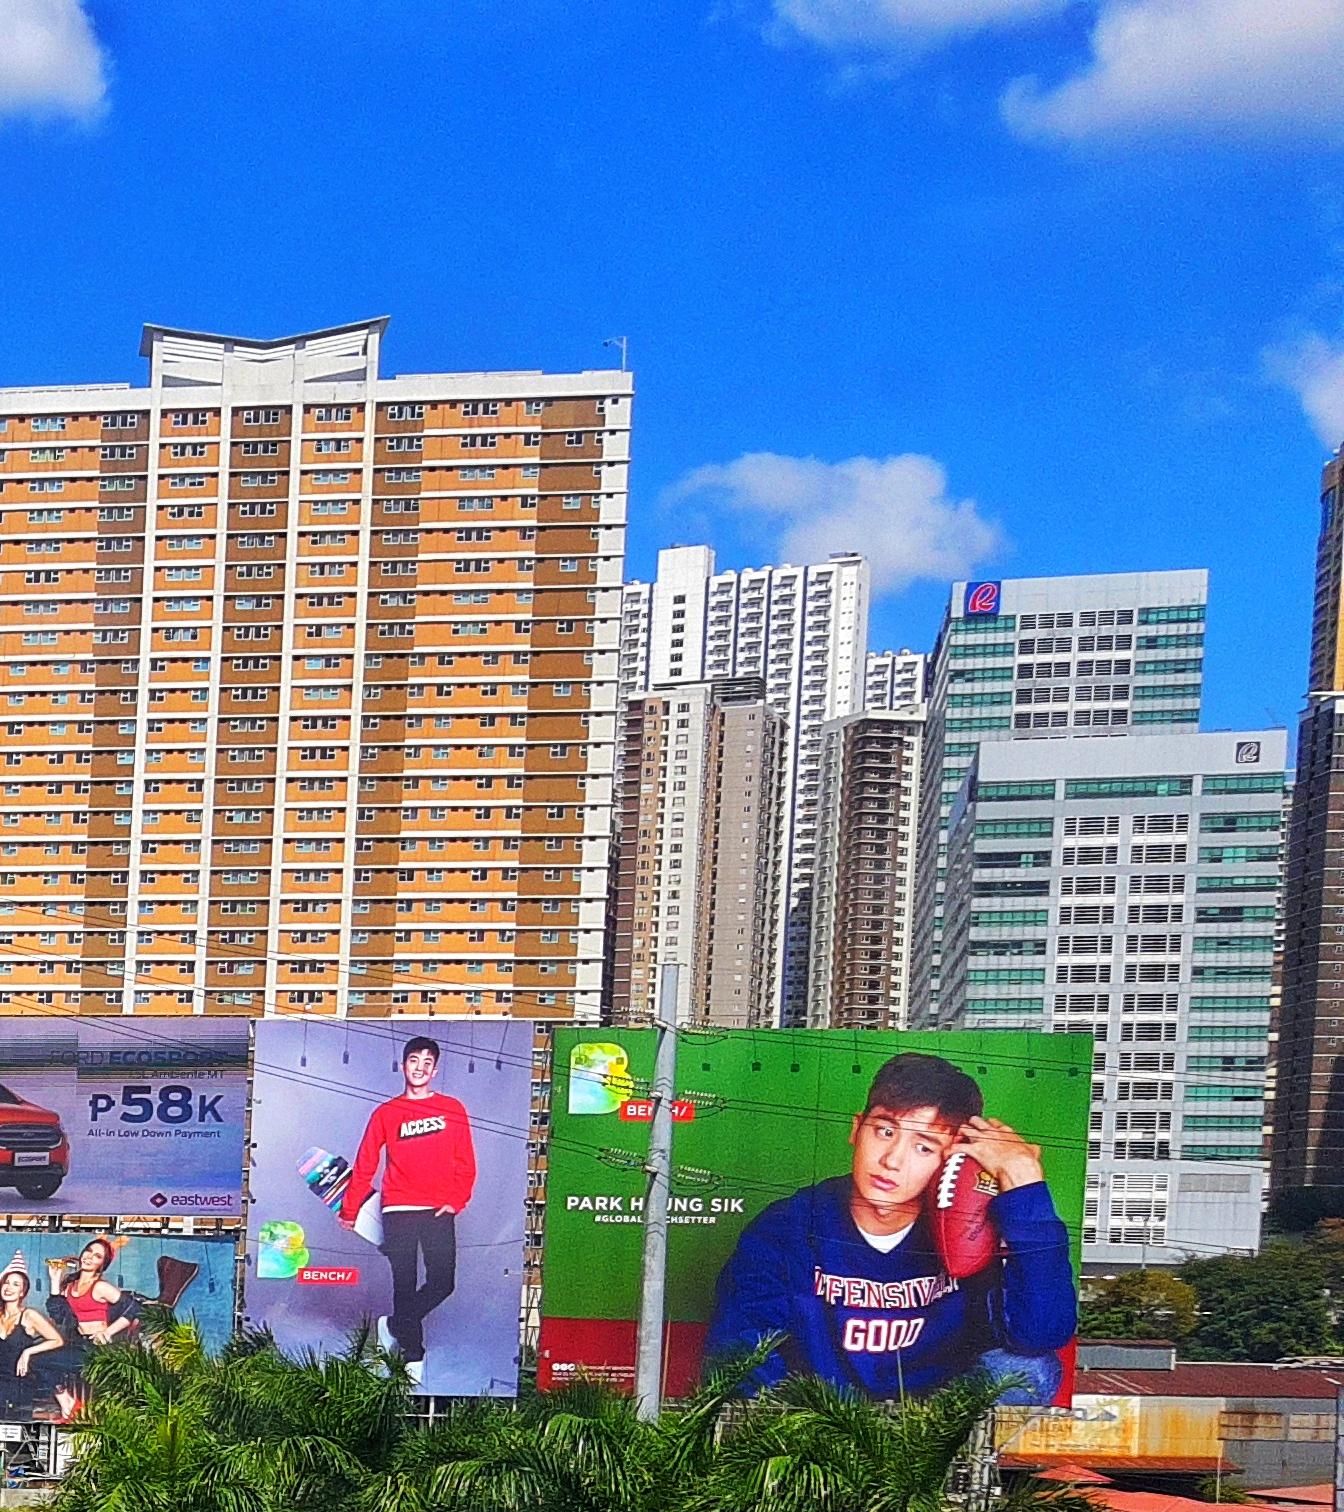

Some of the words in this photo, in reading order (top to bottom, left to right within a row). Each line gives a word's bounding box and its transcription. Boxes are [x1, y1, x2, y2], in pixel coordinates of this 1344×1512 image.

[627, 1105, 687, 1117] BENH/
[87, 1129, 115, 1138] All-in
[117, 1129, 139, 1138] Low
[141, 1129, 171, 1138] Down
[174, 1129, 221, 1139] Payment
[400, 1116, 446, 1138] ACCESS
[171, 1193, 233, 1206] eastwest
[567, 1196, 623, 1211] PARK
[630, 1197, 703, 1212] HUNG
[711, 1198, 744, 1212] SIK
[843, 1317, 925, 1352] GOOD
